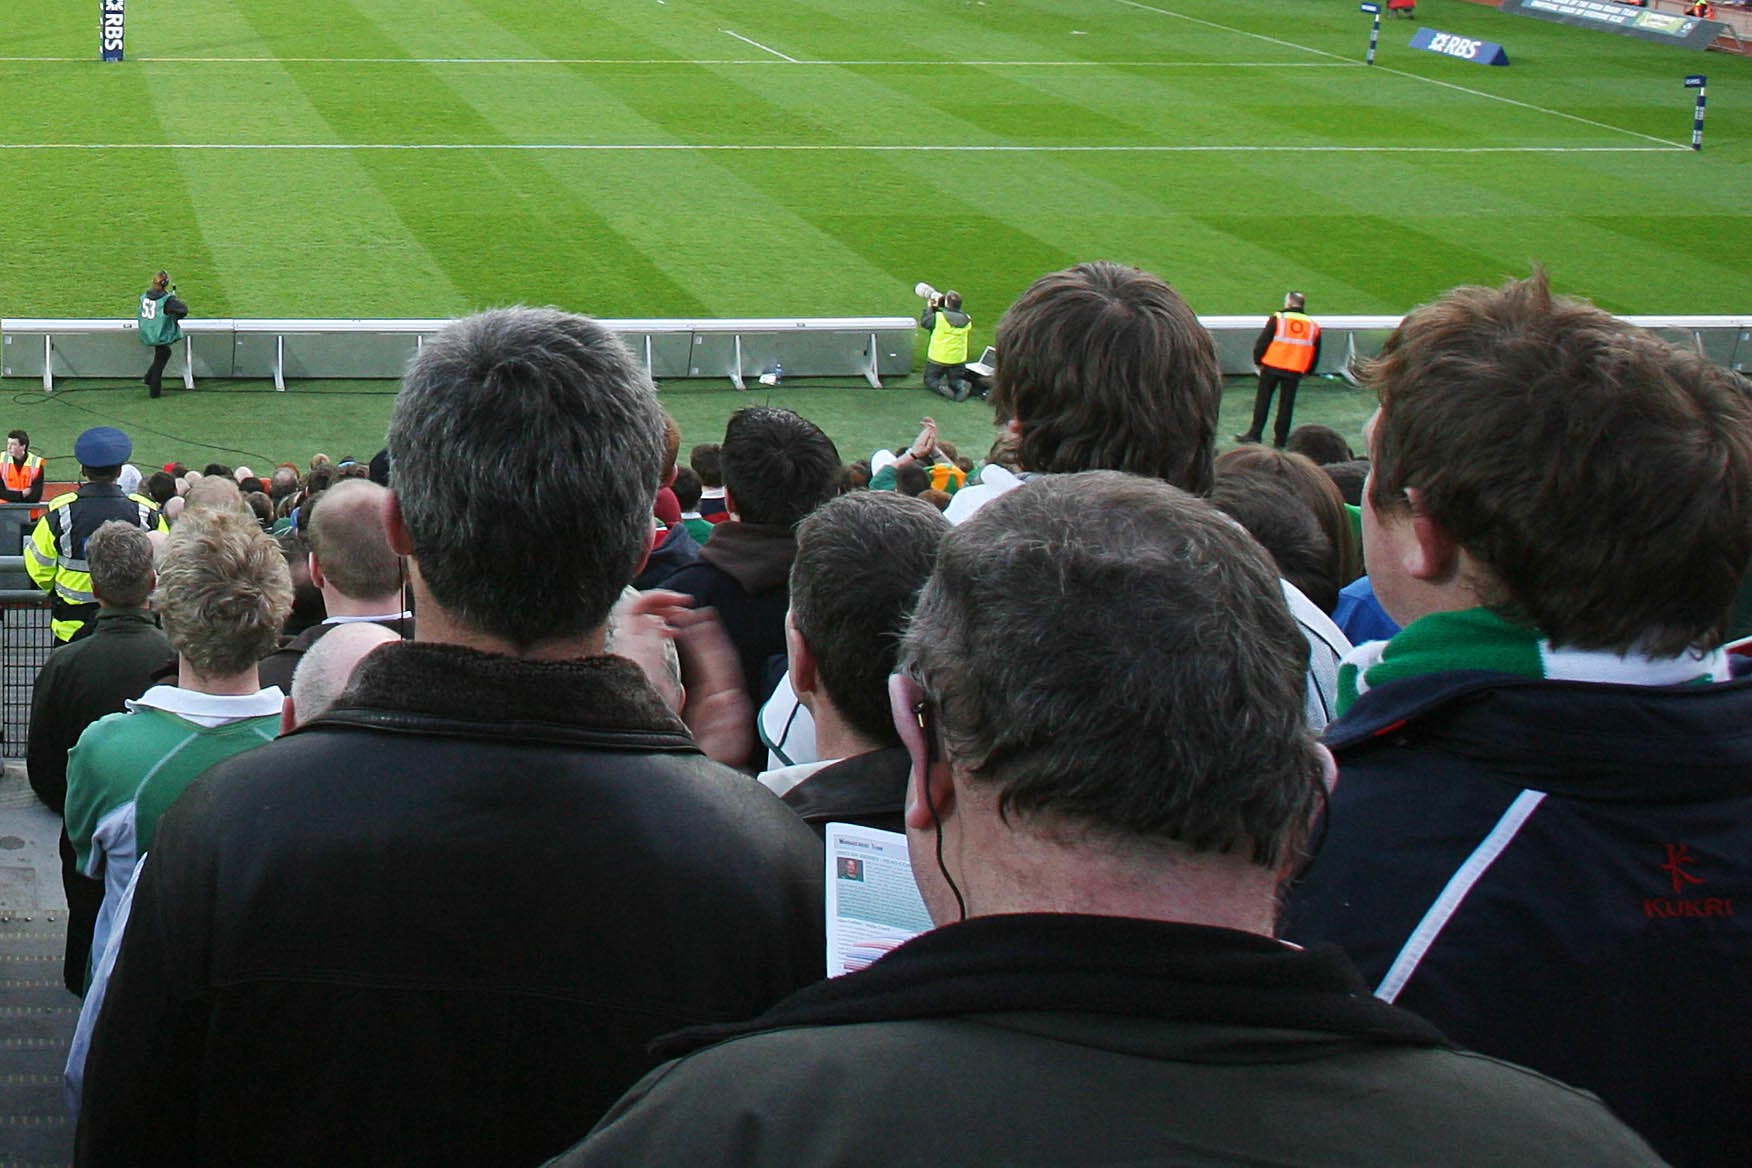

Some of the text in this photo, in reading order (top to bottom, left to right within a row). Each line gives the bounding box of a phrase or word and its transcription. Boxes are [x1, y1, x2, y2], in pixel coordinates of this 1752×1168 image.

[104, 13, 124, 52] RBS
[1447, 35, 1482, 58] RBS
[142, 298, 156, 320] 53
[1643, 898, 1736, 918] KUKRI
